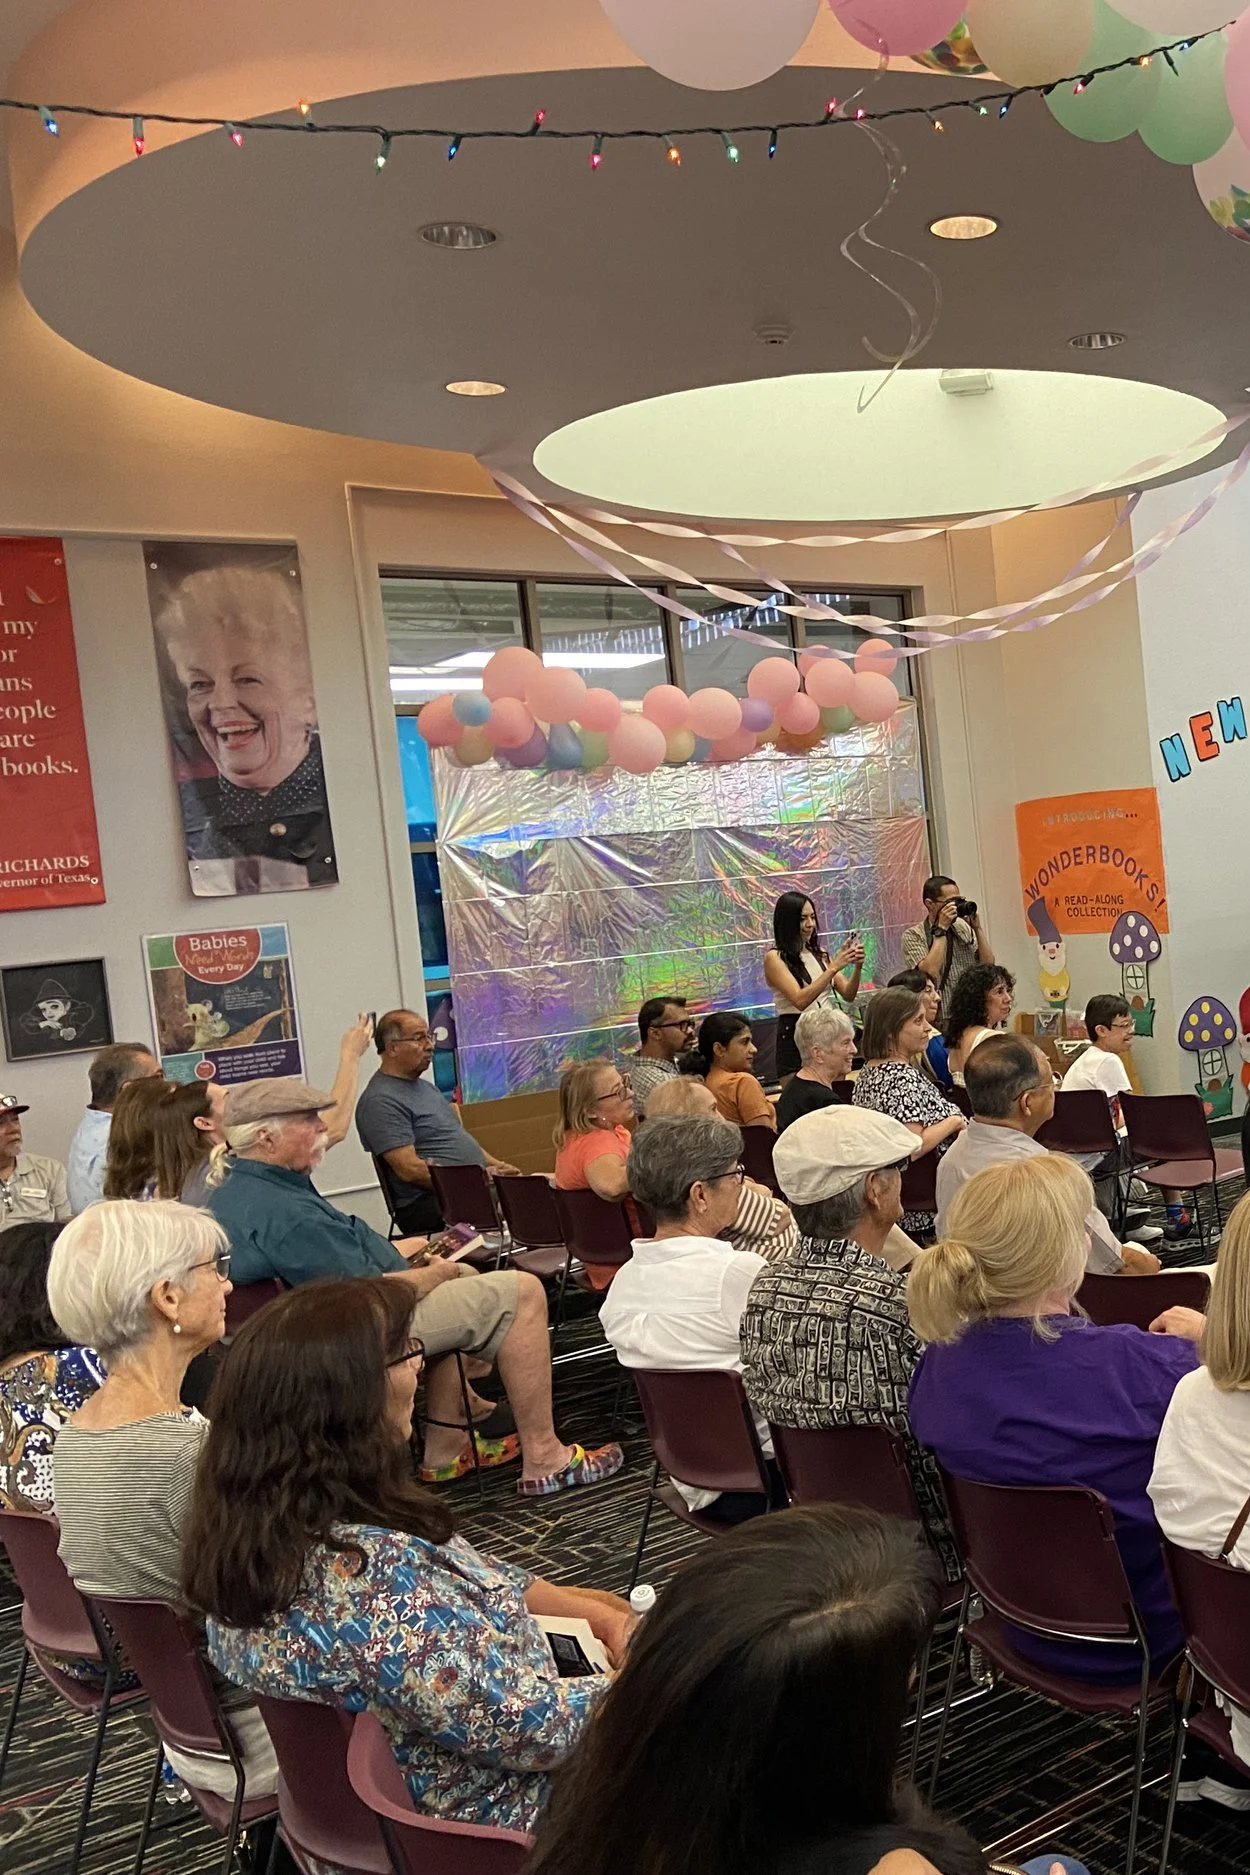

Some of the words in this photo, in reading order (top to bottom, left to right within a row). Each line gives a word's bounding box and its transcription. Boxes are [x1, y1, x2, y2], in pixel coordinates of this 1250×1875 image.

[4, 620, 38, 640] my
[1159, 696, 1248, 782] NEW
[2, 756, 79, 776] books.
[0, 876, 39, 888] ernor
[41, 873, 53, 884] of
[56, 873, 91, 884] Texas
[1025, 845, 1166, 912] WONDERBOOKS!
[1054, 896, 1060, 908] A
[1064, 894, 1124, 905] READ-ALONG
[1066, 907, 1123, 918] COLLECTION
[189, 935, 248, 951] Babies
[185, 951, 213, 966] Need
[198, 965, 225, 975] Every
[226, 963, 244, 972] Day
